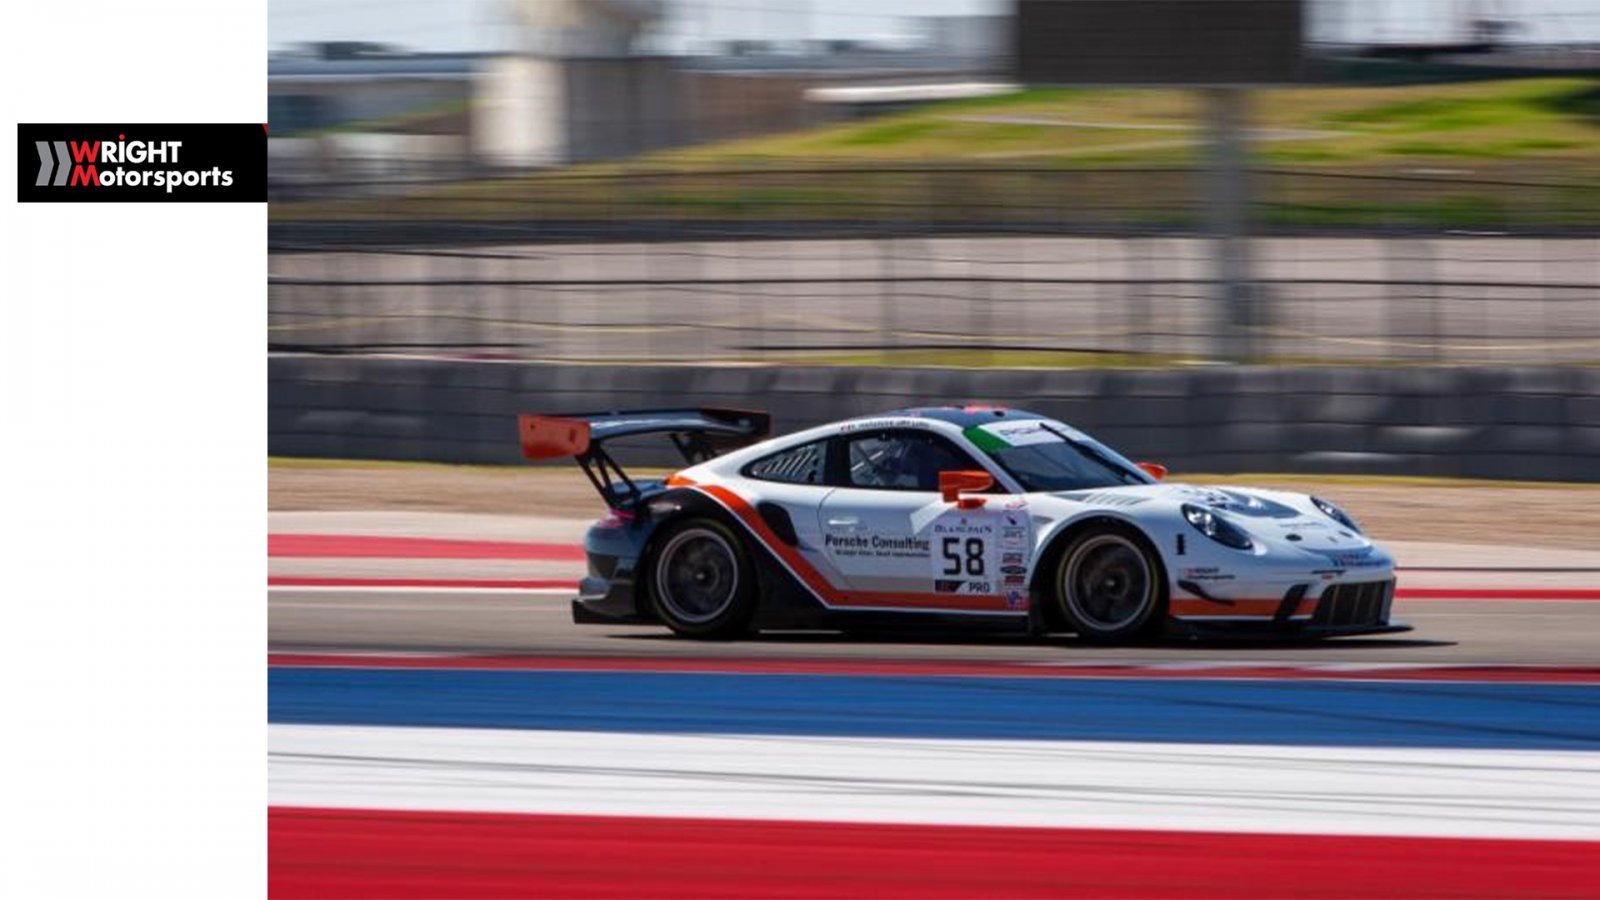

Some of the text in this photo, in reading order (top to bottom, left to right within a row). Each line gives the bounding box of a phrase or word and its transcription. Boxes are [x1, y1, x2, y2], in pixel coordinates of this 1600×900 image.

[825, 533, 930, 551] Porsche Consulting
[942, 536, 985, 576] 58
[969, 582, 990, 593] PRO
